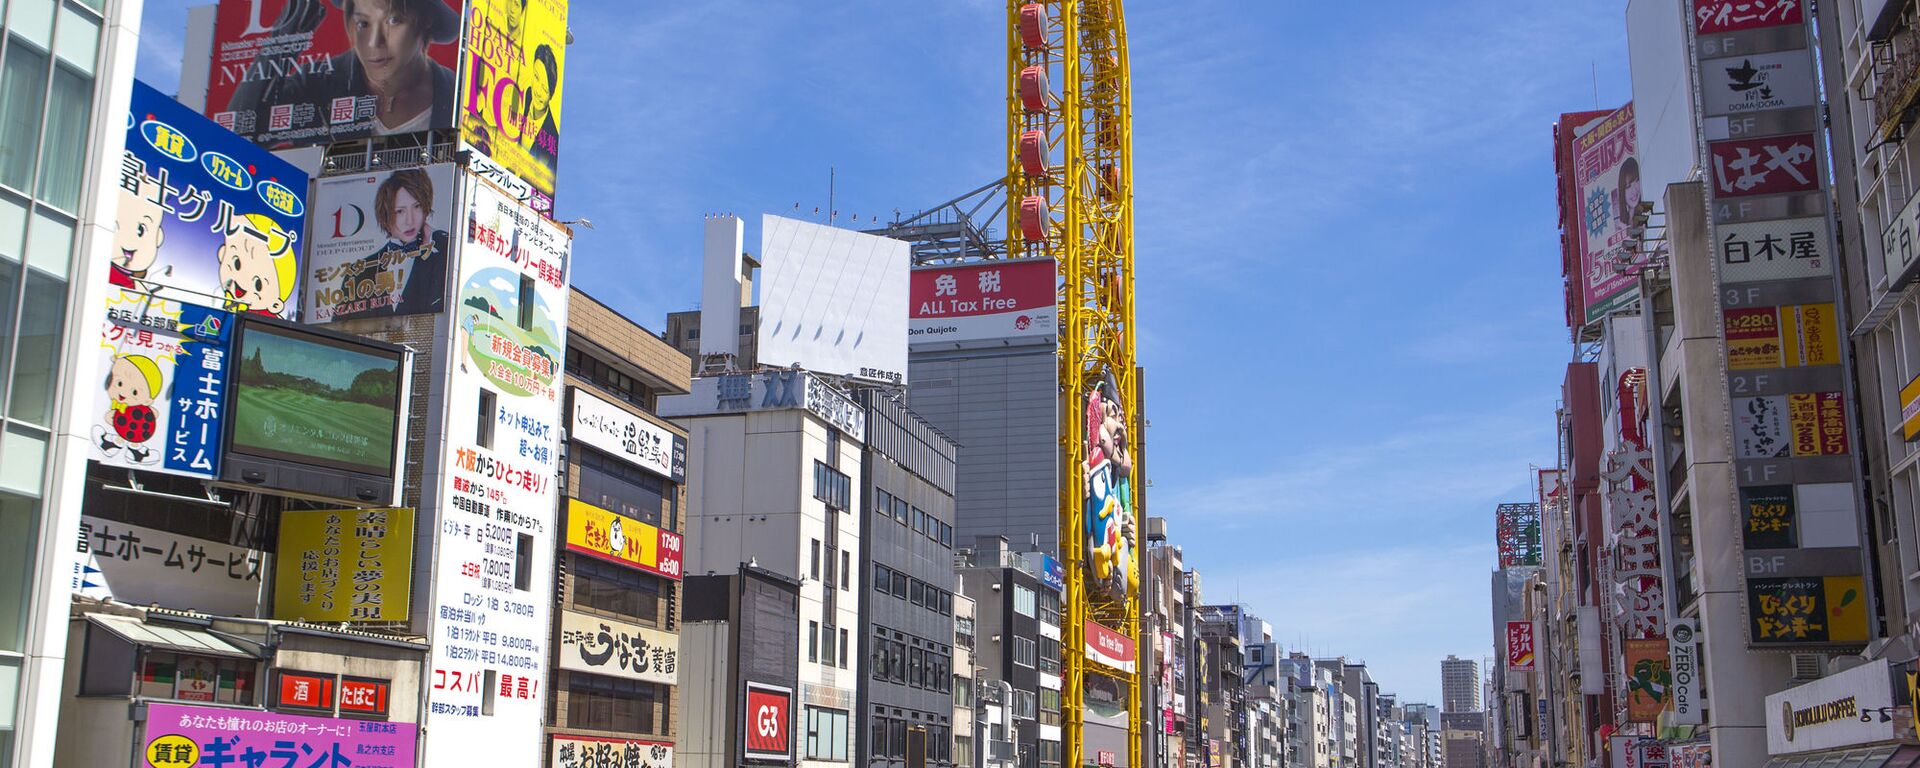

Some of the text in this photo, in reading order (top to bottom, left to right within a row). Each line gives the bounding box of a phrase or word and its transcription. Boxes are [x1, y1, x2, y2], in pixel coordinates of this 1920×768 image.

[1697, 0, 1796, 30] ダイニング
[470, 26, 512, 74] HOST
[471, 7, 526, 67] OSAKA
[218, 52, 335, 86] NYANNYA
[330, 95, 378, 124] 最高
[1729, 117, 1756, 135] 5F
[155, 126, 185, 159] 賃貸
[211, 155, 243, 187] リフォーム
[120, 151, 298, 257] 富士グループ
[1718, 202, 1752, 219] 4F
[1724, 231, 1820, 264] 白木屋
[314, 240, 437, 284] モンスターグループ
[934, 270, 1002, 297] 免税
[1726, 288, 1760, 305] 3F
[315, 300, 367, 320] KANZAKI
[919, 297, 1017, 315] ALL Tax Free
[908, 325, 958, 337] Don Quijote
[859, 366, 903, 381] 意匠作成中
[1733, 375, 1768, 393] 2F
[190, 348, 224, 471] 富士ホーム
[172, 397, 193, 462] サービス
[1744, 463, 1777, 482] 1F
[1750, 502, 1788, 518] びっくり
[1750, 518, 1792, 533] ドンキー
[77, 521, 262, 583] 富士ホームサービス
[661, 533, 680, 552] 17:00
[320, 514, 342, 611] あなたのお店づくり
[351, 512, 387, 620] 素晴らしい夢の実現
[1751, 555, 1785, 574] B1F
[300, 551, 319, 604] 応援します
[1759, 593, 1816, 615] びっくり
[482, 632, 497, 646] 平日
[1519, 623, 1531, 653] ツルハ
[1757, 616, 1823, 638] ドンキー
[481, 651, 496, 665] 平日
[1510, 628, 1520, 660] ドラッグ
[1675, 646, 1691, 685] ZERO
[293, 680, 309, 702] 酒
[434, 669, 481, 694] コスパ
[341, 685, 375, 707] たばこ
[757, 704, 779, 738] G3
[1794, 695, 1857, 728] HONOLULU COFFEE
[153, 742, 193, 765] 賃貸
[201, 734, 353, 768] ギャラント
